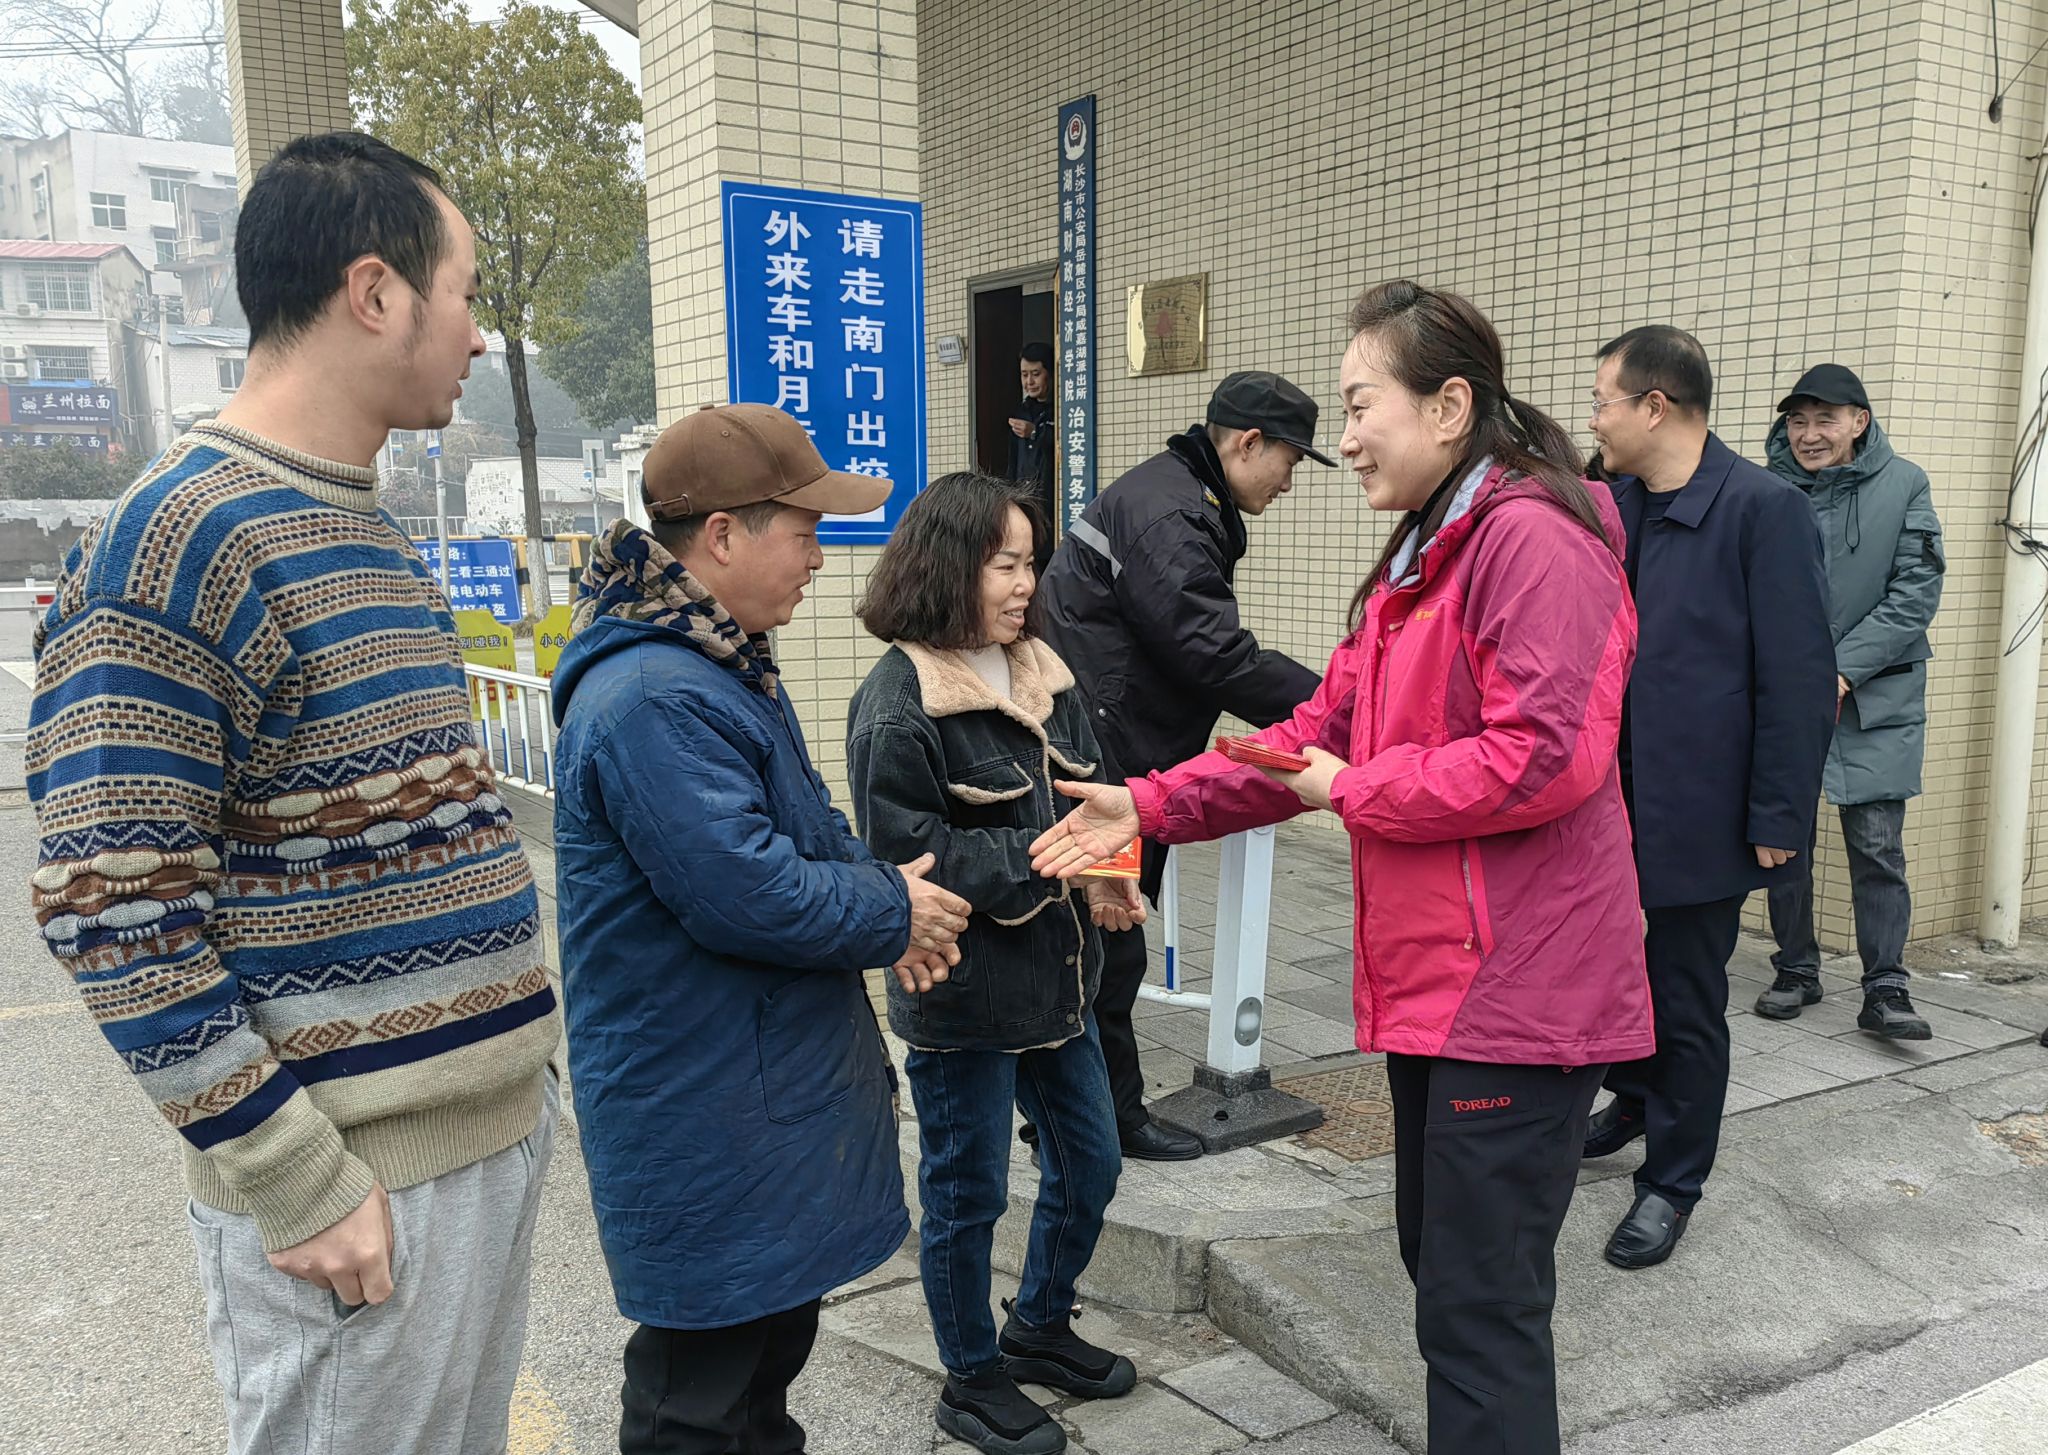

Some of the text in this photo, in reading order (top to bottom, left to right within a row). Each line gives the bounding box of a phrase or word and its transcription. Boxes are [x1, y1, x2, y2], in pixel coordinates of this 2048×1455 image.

[1063, 169, 1074, 402] 湖南财政经济学院
[42, 392, 111, 410] 兰州拉面
[1068, 406, 1086, 522] 治安警务室
[1449, 1096, 1512, 1112] TOREAD
